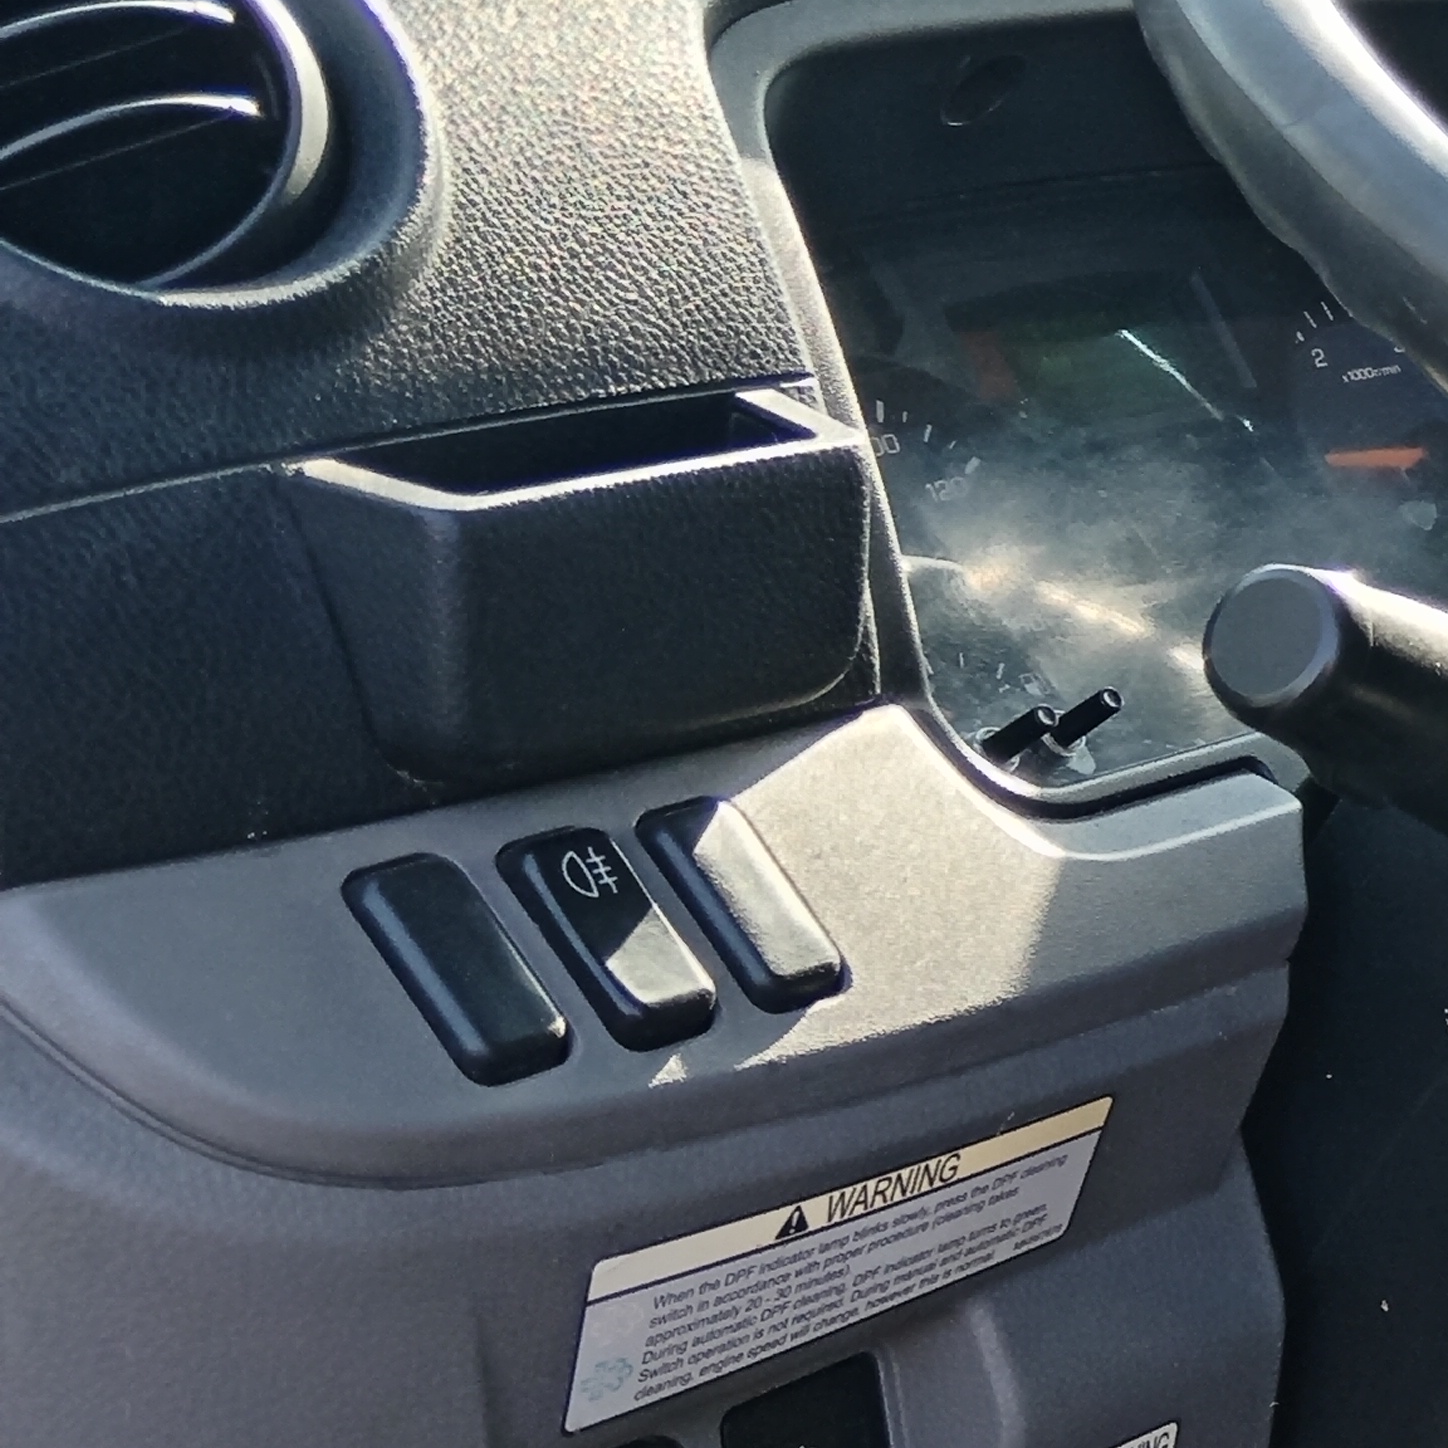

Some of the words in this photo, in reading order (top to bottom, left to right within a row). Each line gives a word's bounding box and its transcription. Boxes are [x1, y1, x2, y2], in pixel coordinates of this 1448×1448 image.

[1311, 348, 1327, 368] 2
[827, 1153, 960, 1221] WARNING
[653, 1287, 695, 1309] When
[698, 1278, 721, 1295] the
[723, 1264, 757, 1287] DPF
[970, 1184, 989, 1198] the
[991, 1170, 1018, 1190] DPF
[641, 1340, 688, 1365] During
[691, 1315, 757, 1347] automatic
[759, 1300, 792, 1322] DPF
[851, 1265, 881, 1287] DPF
[649, 1304, 693, 1328] switch
[696, 1299, 710, 1312] in
[713, 1272, 791, 1307] accordance
[794, 1260, 821, 1278] with
[744, 1295, 763, 1312] 20
[773, 1284, 792, 1301] 30
[637, 1357, 684, 1383] Switch
[849, 1279, 891, 1303] During
